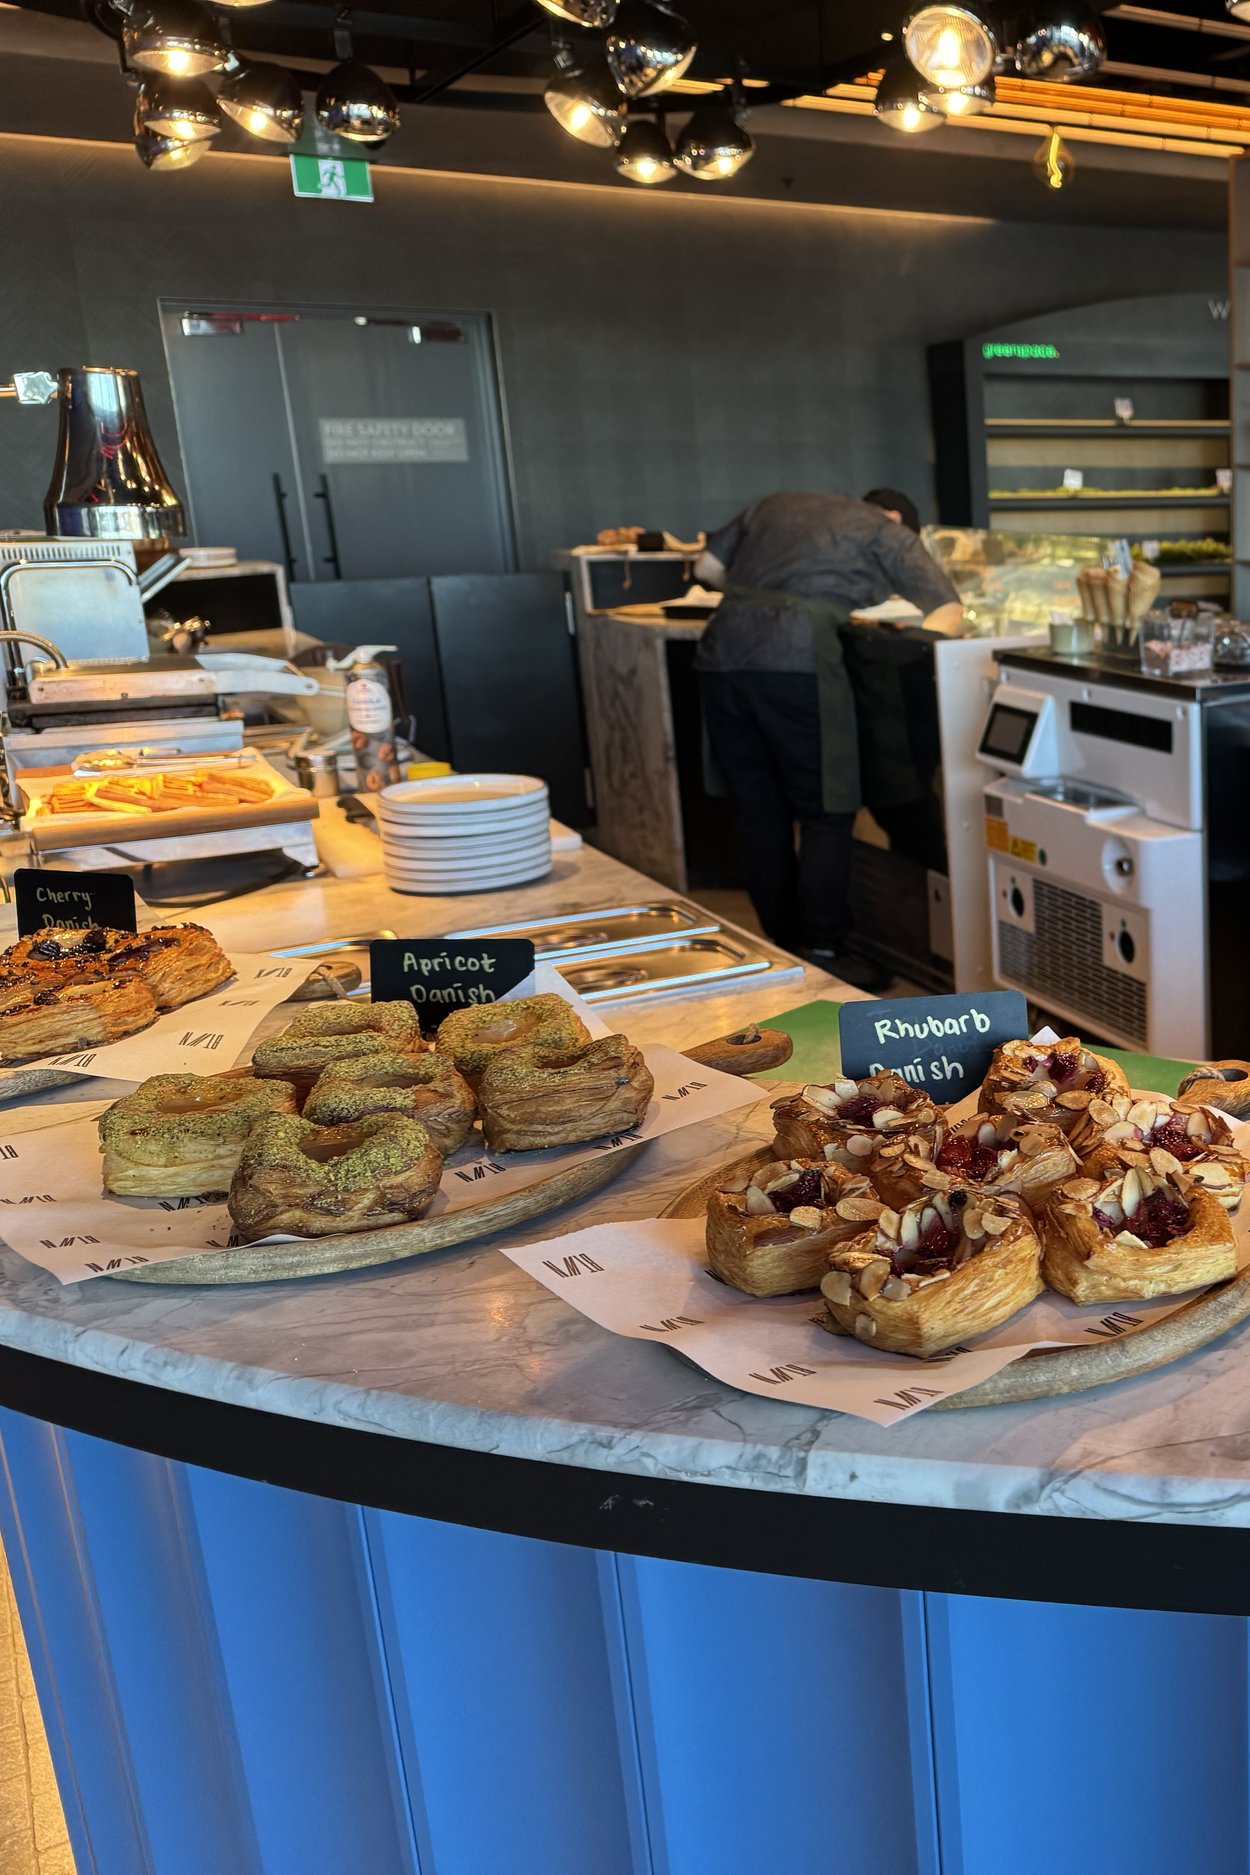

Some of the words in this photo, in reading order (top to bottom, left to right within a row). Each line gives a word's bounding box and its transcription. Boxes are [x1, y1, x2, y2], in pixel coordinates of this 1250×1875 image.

[36, 887, 92, 911] Cherry
[403, 952, 496, 976] Apricot
[409, 983, 496, 1004] Danish
[873, 1008, 991, 1045] Rhubarb
